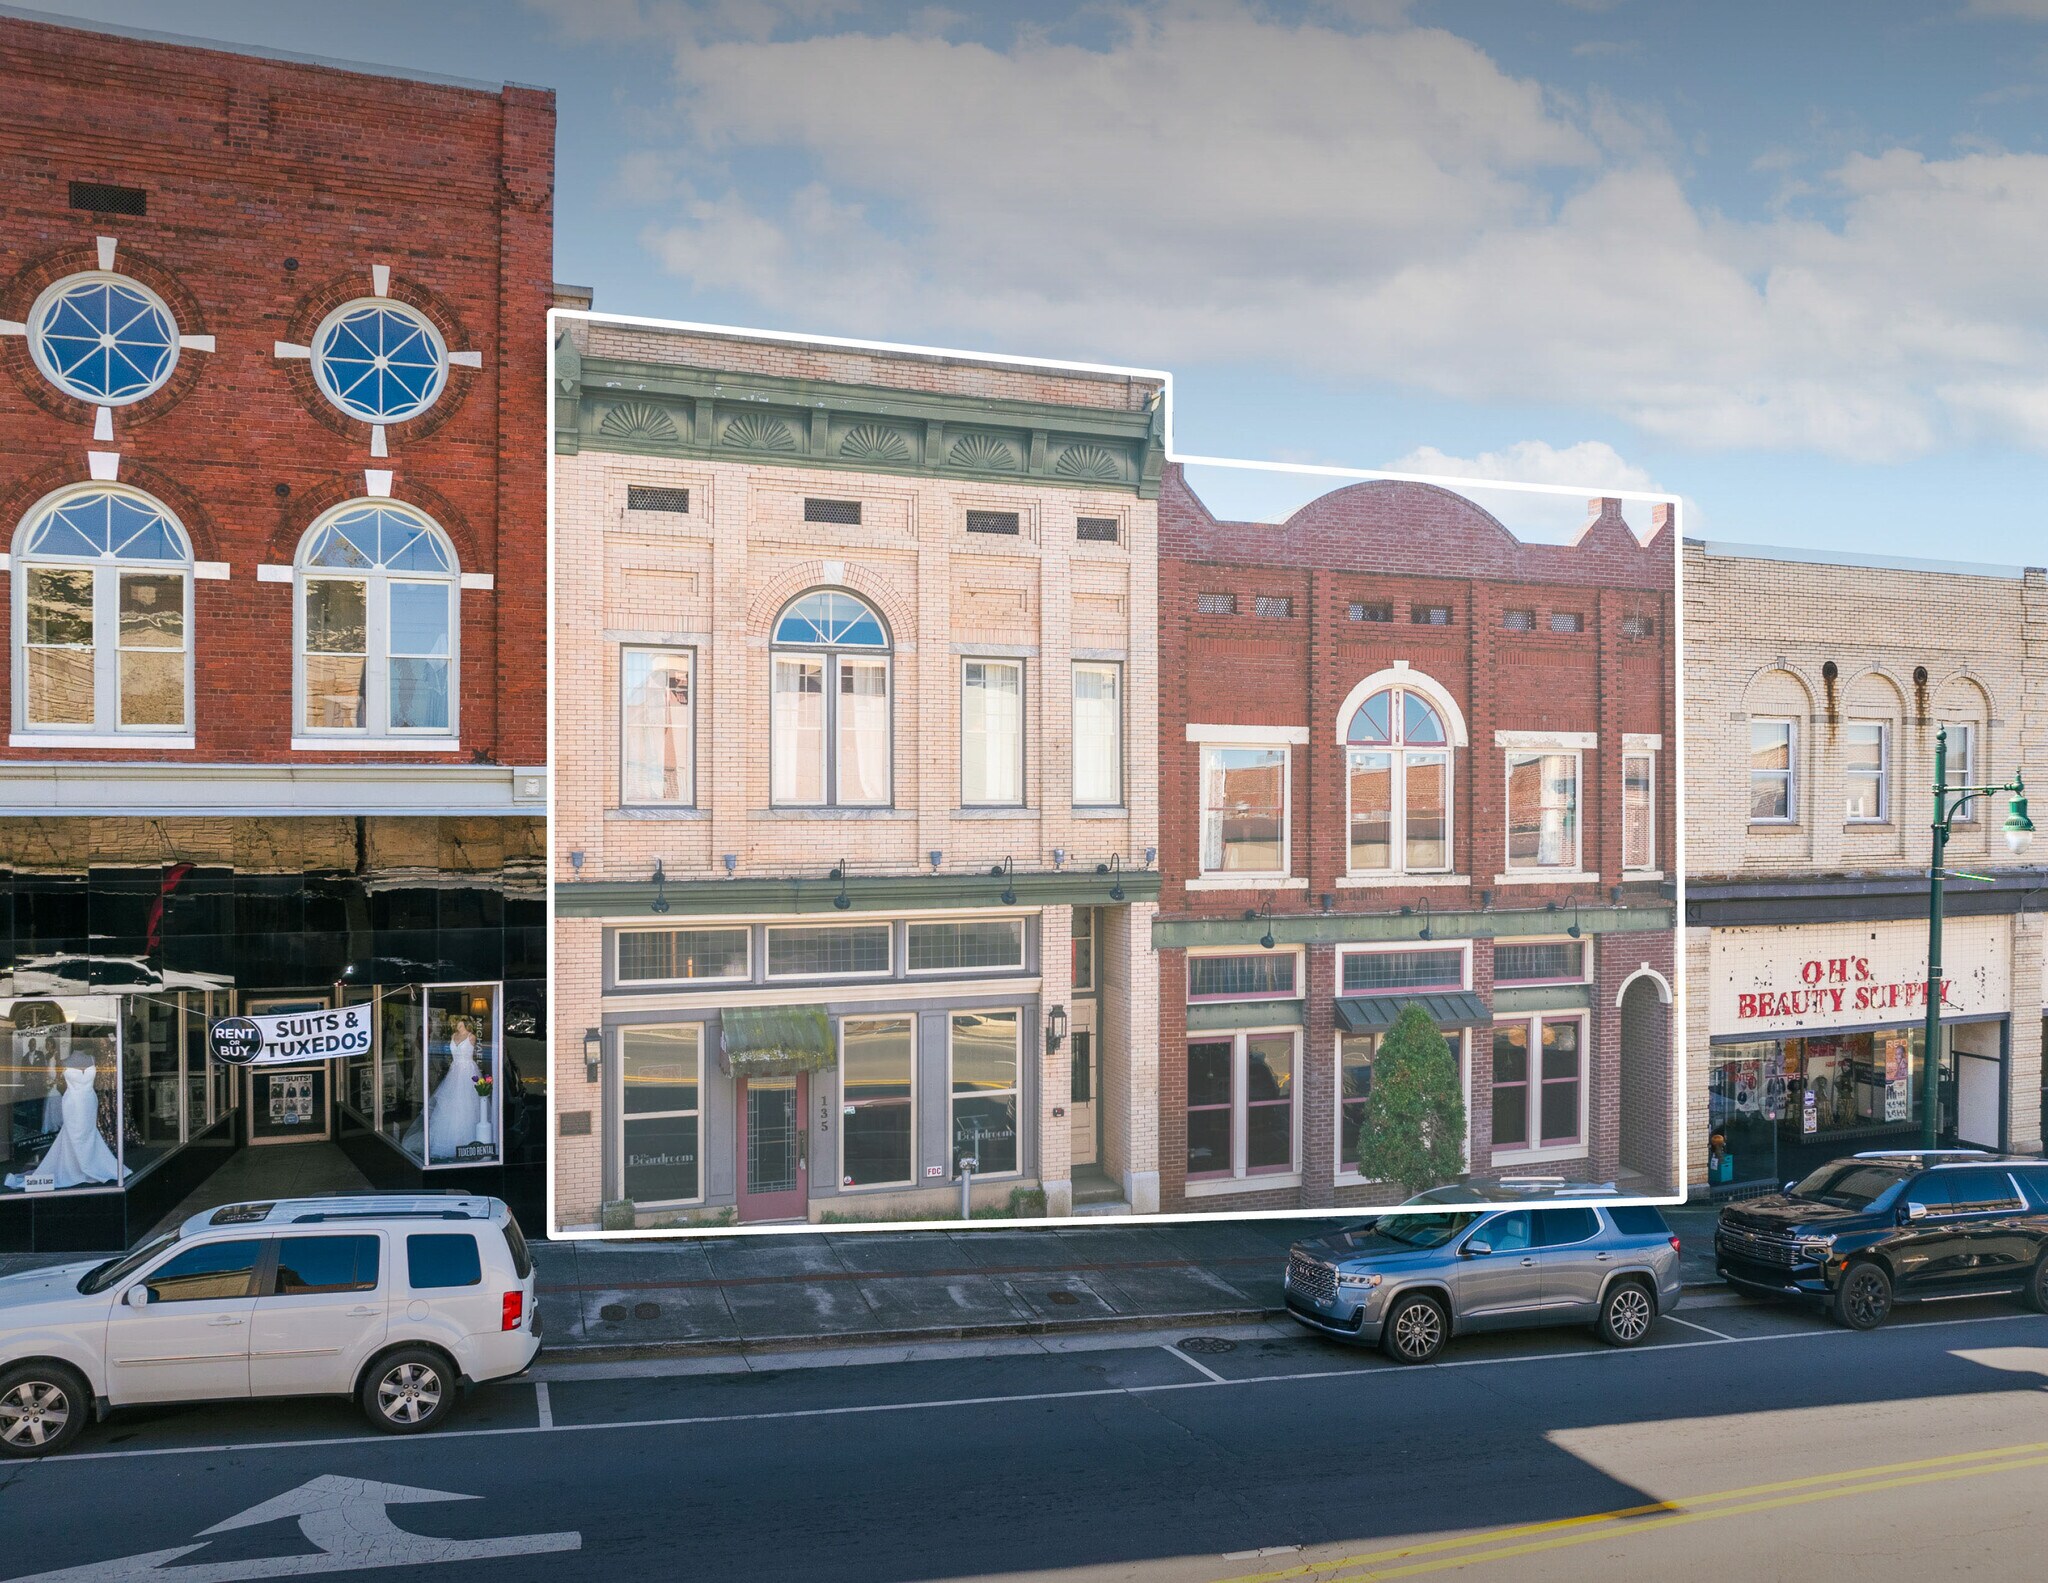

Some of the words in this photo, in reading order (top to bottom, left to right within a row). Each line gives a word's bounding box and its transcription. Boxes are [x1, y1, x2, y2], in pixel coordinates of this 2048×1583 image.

[1802, 956, 1870, 984] OH'S
[1738, 988, 1846, 1019] BEAUTY
[49, 1024, 68, 1034] KORS
[215, 1028, 255, 1040] RENT
[276, 1014, 340, 1038] SUITS
[344, 1011, 359, 1029] &
[220, 1045, 250, 1057] BUY
[264, 1031, 368, 1058] TUXEDOS
[475, 1017, 484, 1065] MICHAEL
[1886, 1039, 1907, 1049] RED
[820, 1096, 829, 1132] 135
[457, 1146, 477, 1158] TUXEDO
[476, 1145, 495, 1157] RENTAL
[927, 1167, 942, 1176] FDC
